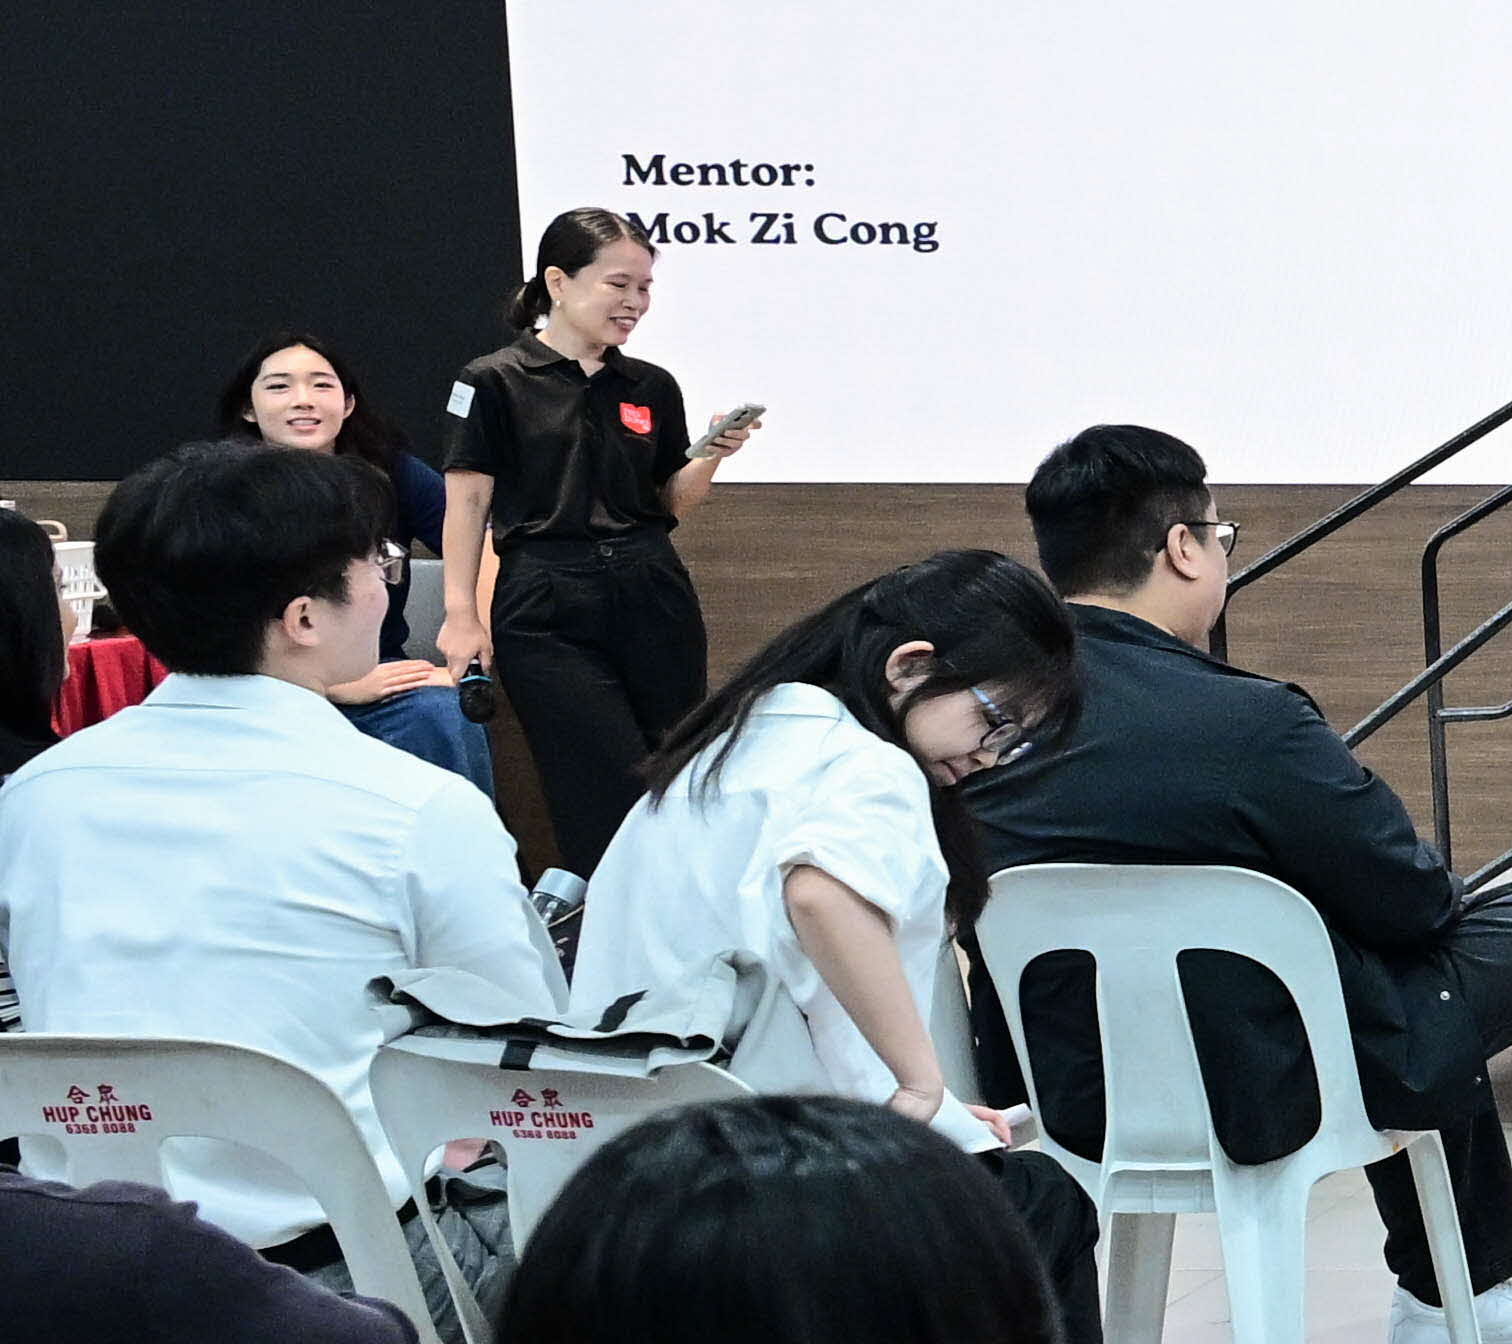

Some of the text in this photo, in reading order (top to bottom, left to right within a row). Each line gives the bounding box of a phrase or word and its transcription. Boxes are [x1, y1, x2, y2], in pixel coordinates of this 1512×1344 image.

[621, 153, 815, 187] Mentor:
[626, 212, 940, 254] Mok Zi Cong
[42, 1104, 152, 1122] HUP CHUNG
[490, 1111, 594, 1128] HUP CHUNG
[66, 1123, 135, 1134] 6368 8088
[513, 1130, 576, 1139] 6368 8088
